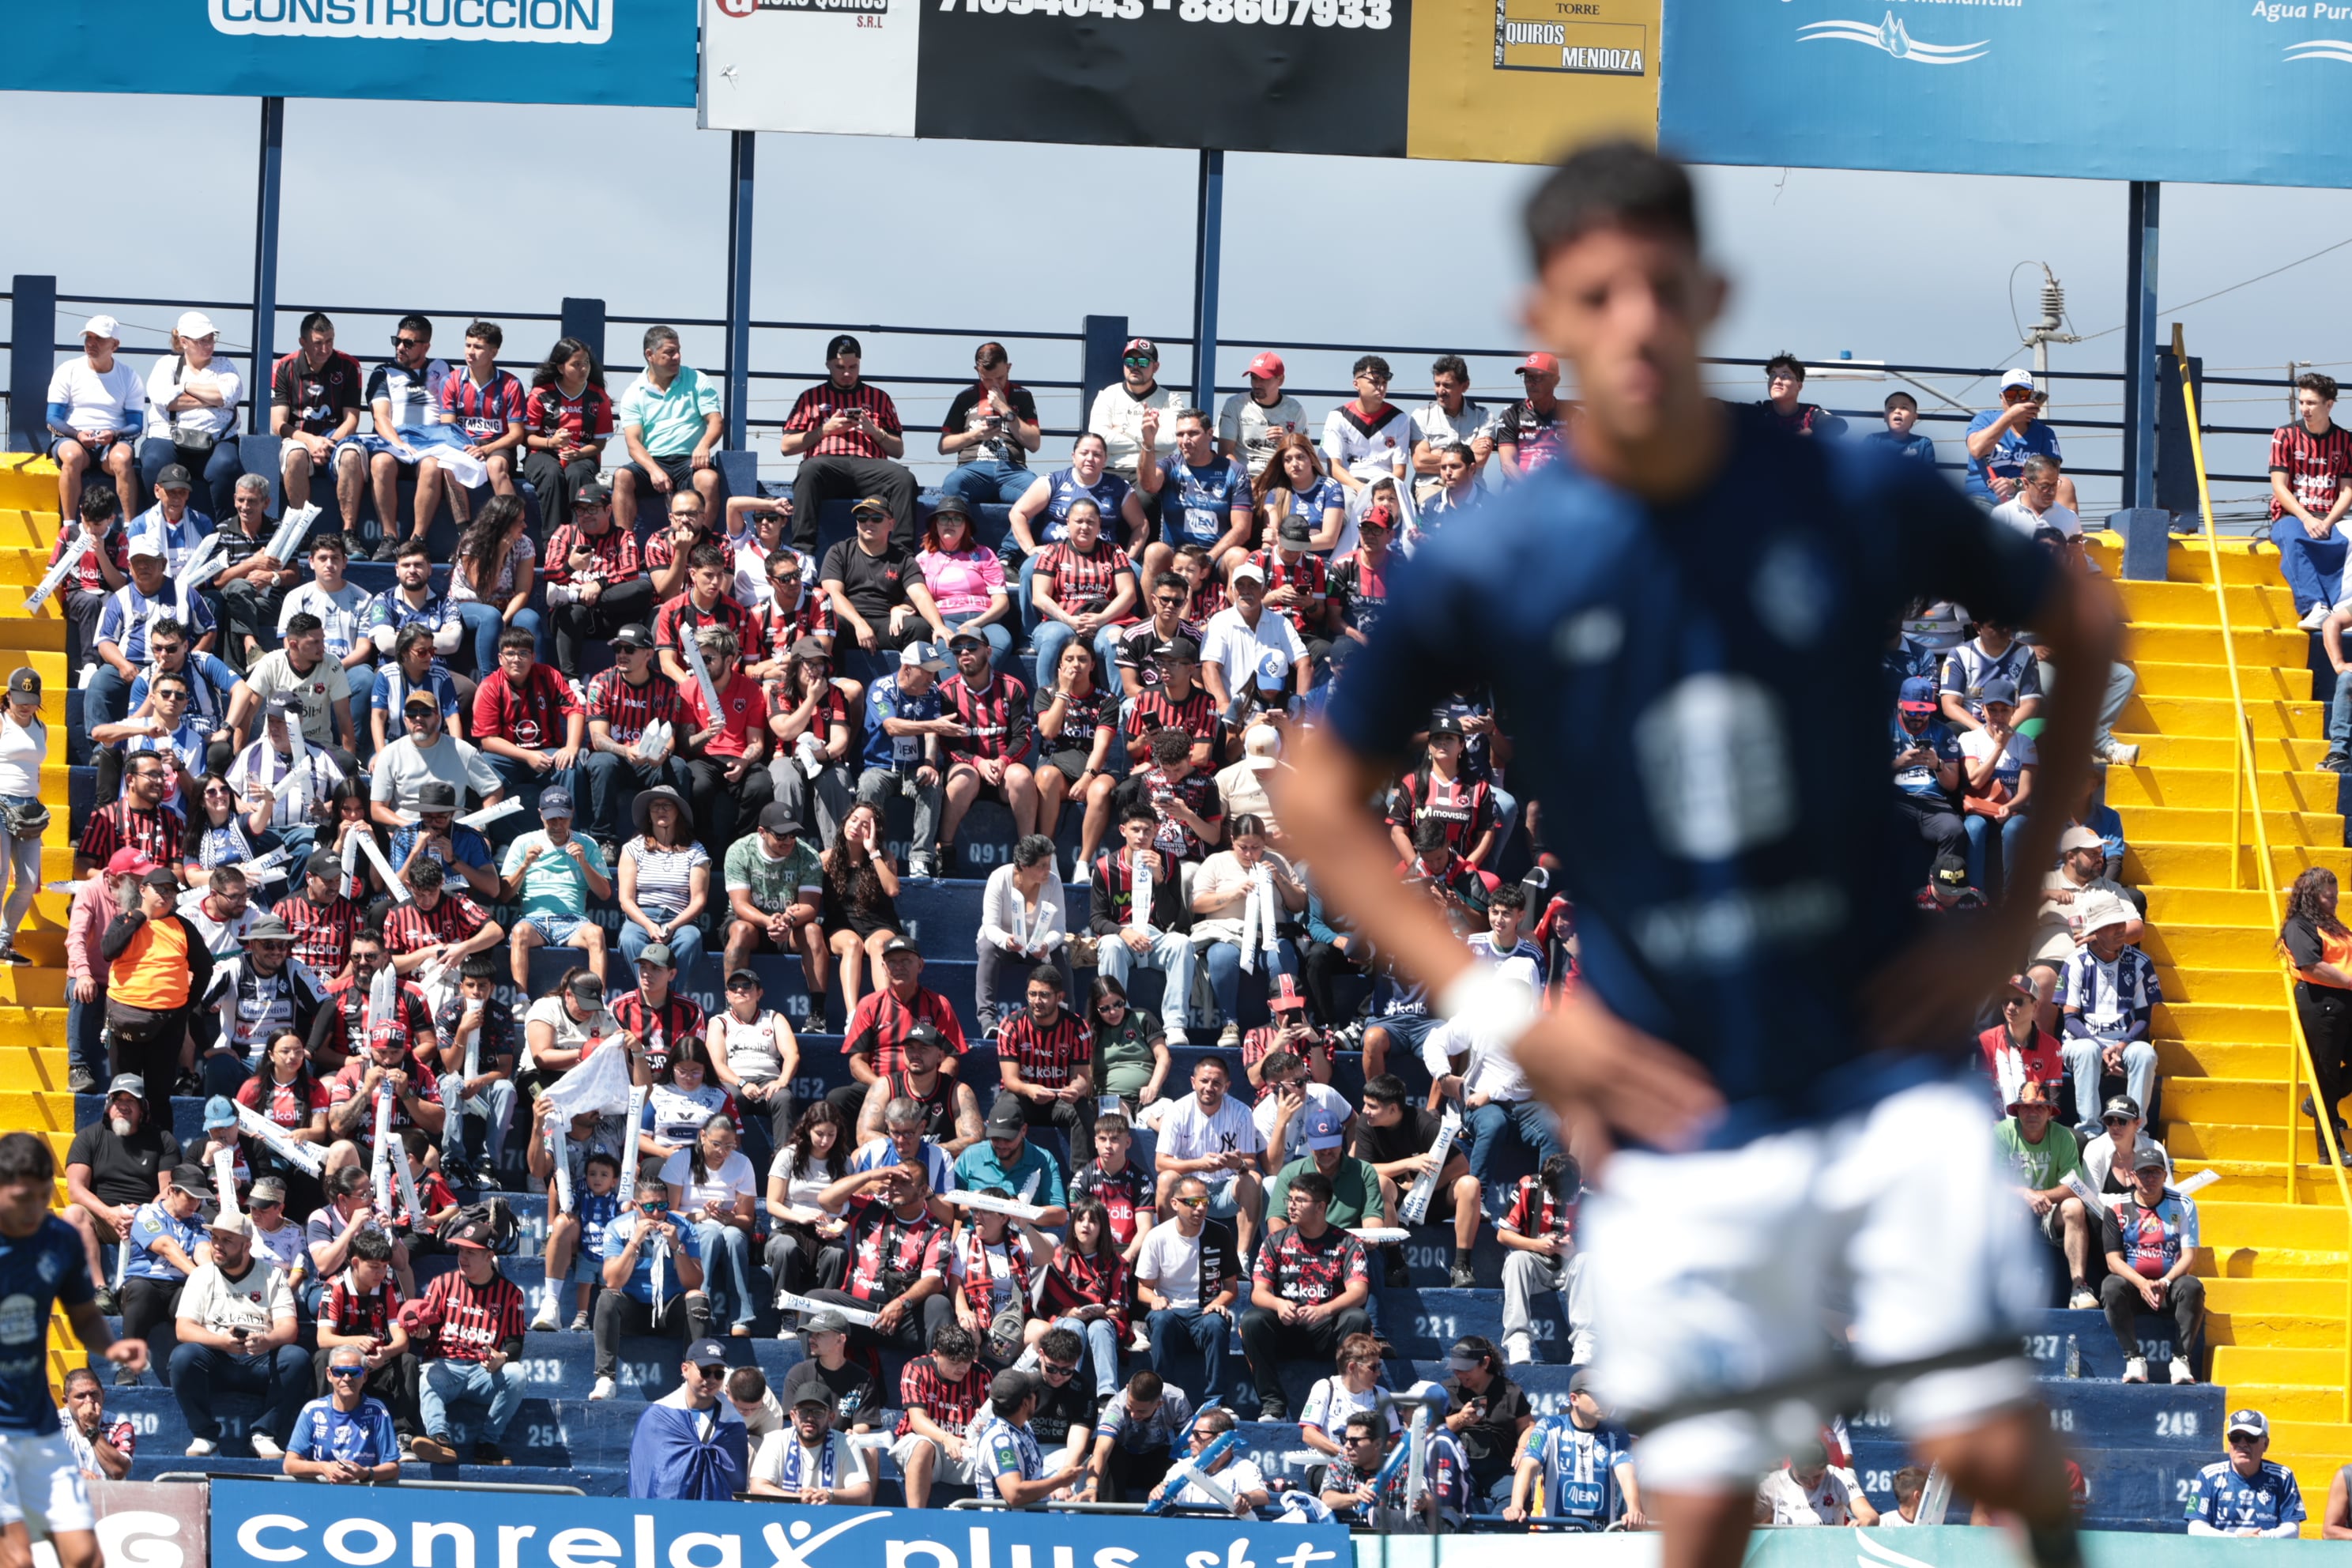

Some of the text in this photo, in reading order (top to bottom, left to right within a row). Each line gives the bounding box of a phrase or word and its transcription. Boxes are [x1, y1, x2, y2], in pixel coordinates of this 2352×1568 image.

[1556, 2, 1600, 15] TORRE
[2251, 0, 2352, 22] Agua Pur
[857, 15, 883, 28] S.R.L
[1505, 21, 1565, 45] QUIRÓS
[1562, 47, 1642, 70] MENDOZA
[2307, 473, 2337, 488] kölbi
[1077, 582, 1111, 594] kölbi
[300, 704, 323, 719] ölbi
[1063, 723, 1095, 739] kölb
[1432, 809, 1470, 821] movistar
[260, 853, 284, 871] teki
[969, 842, 1008, 864] 091
[444, 873, 462, 884] eki
[763, 896, 793, 910] kölb
[307, 942, 341, 956] kölbi
[786, 994, 811, 1016] 13
[1035, 1065, 1068, 1079] kölbi
[791, 1077, 824, 1099] 152
[628, 1091, 640, 1116] teki
[275, 1110, 303, 1121] kölb
[1438, 1125, 1453, 1149] teki
[620, 1170, 631, 1196] teki
[2071, 1180, 2086, 1197] teki
[1413, 1197, 1427, 1220] teki
[486, 1238, 495, 1249] 12
[1408, 1246, 1446, 1267] 200
[1298, 1283, 1333, 1298] kölbi
[786, 1295, 811, 1310] teki
[229, 1312, 265, 1325] kölbi
[1415, 1317, 1455, 1338] 221
[459, 1326, 496, 1344] kölbi
[2022, 1336, 2060, 1358] 227
[521, 1359, 560, 1382] 233
[620, 1363, 662, 1385] 234
[1237, 1383, 1261, 1404] 24
[939, 1421, 967, 1435] kölb
[2156, 1412, 2196, 1436] 249
[528, 1423, 568, 1447] 254
[1865, 1469, 1897, 1493] 26
